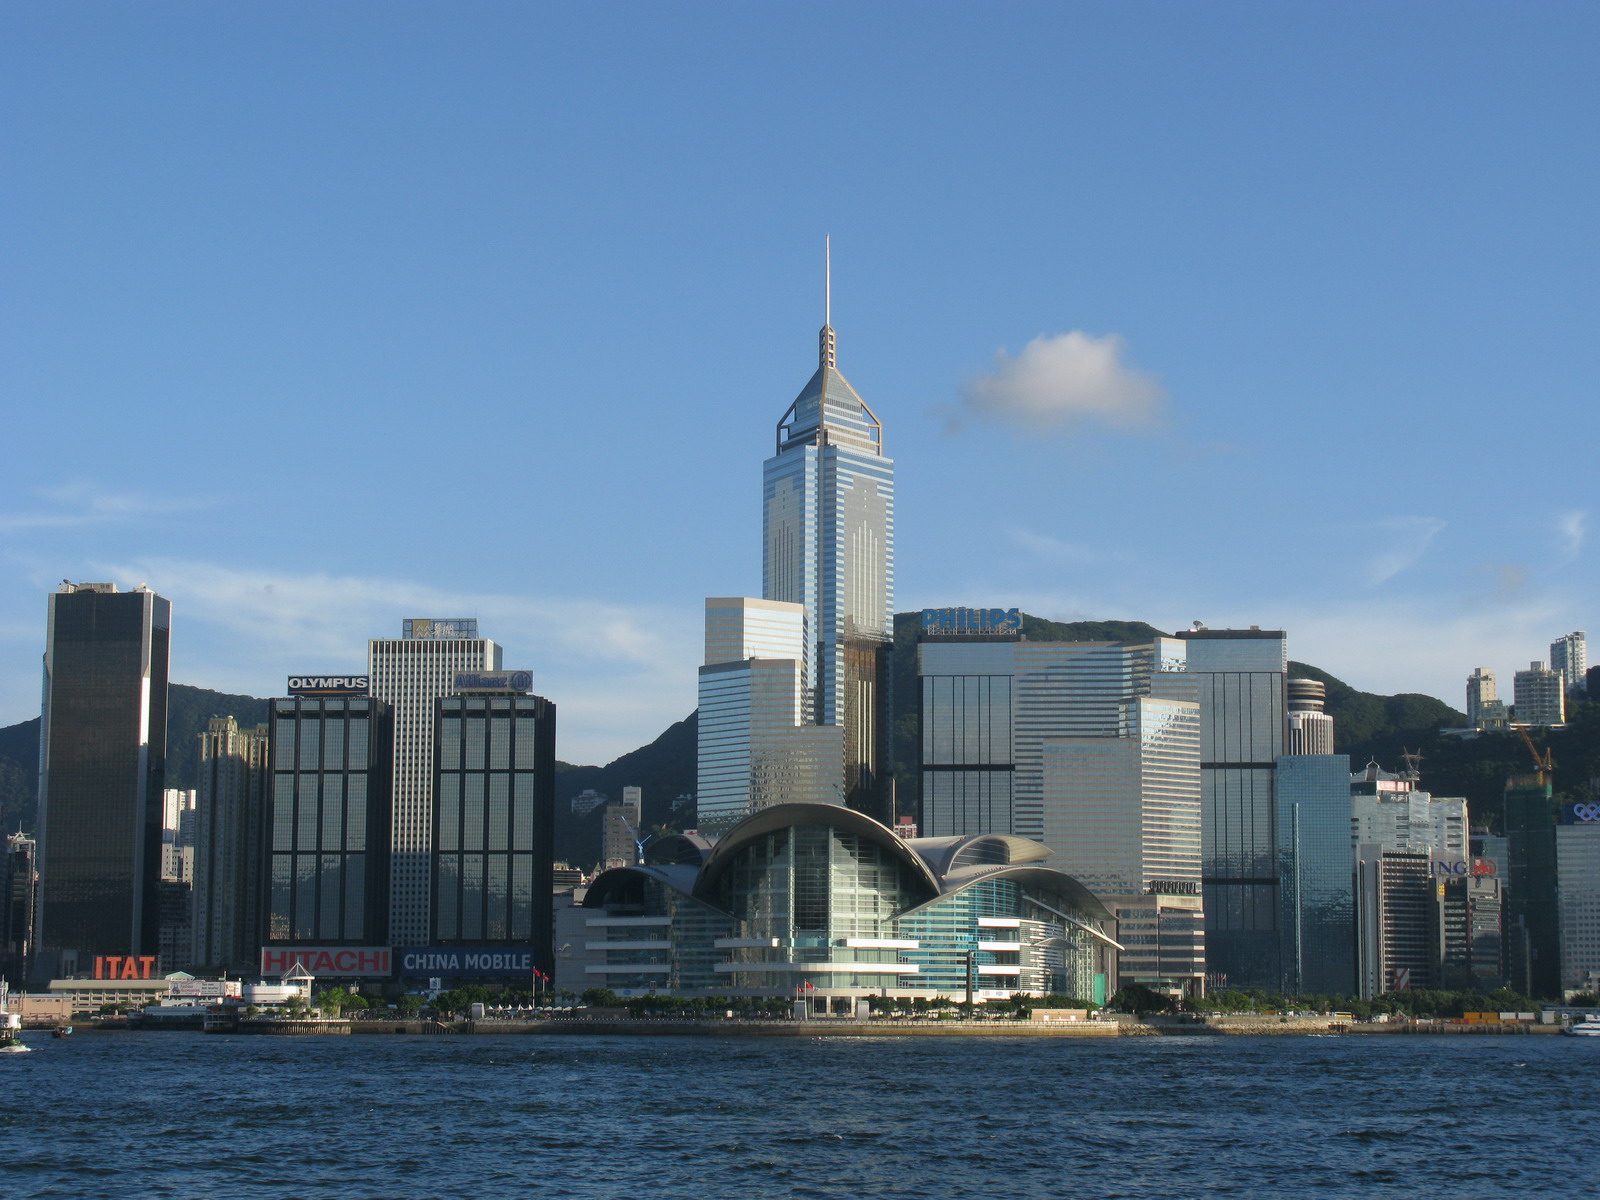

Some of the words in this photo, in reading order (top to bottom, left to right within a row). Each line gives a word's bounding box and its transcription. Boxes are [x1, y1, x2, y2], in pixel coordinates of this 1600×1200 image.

[922, 608, 1022, 629] PHILIPS
[288, 677, 368, 689] OLYMPUS
[456, 673, 508, 687] Allianz
[1430, 861, 1467, 875] ING
[95, 956, 155, 980] ITAT
[264, 950, 389, 972] HITACHI
[403, 953, 460, 970] CHINA
[464, 953, 531, 970] MOBILE
